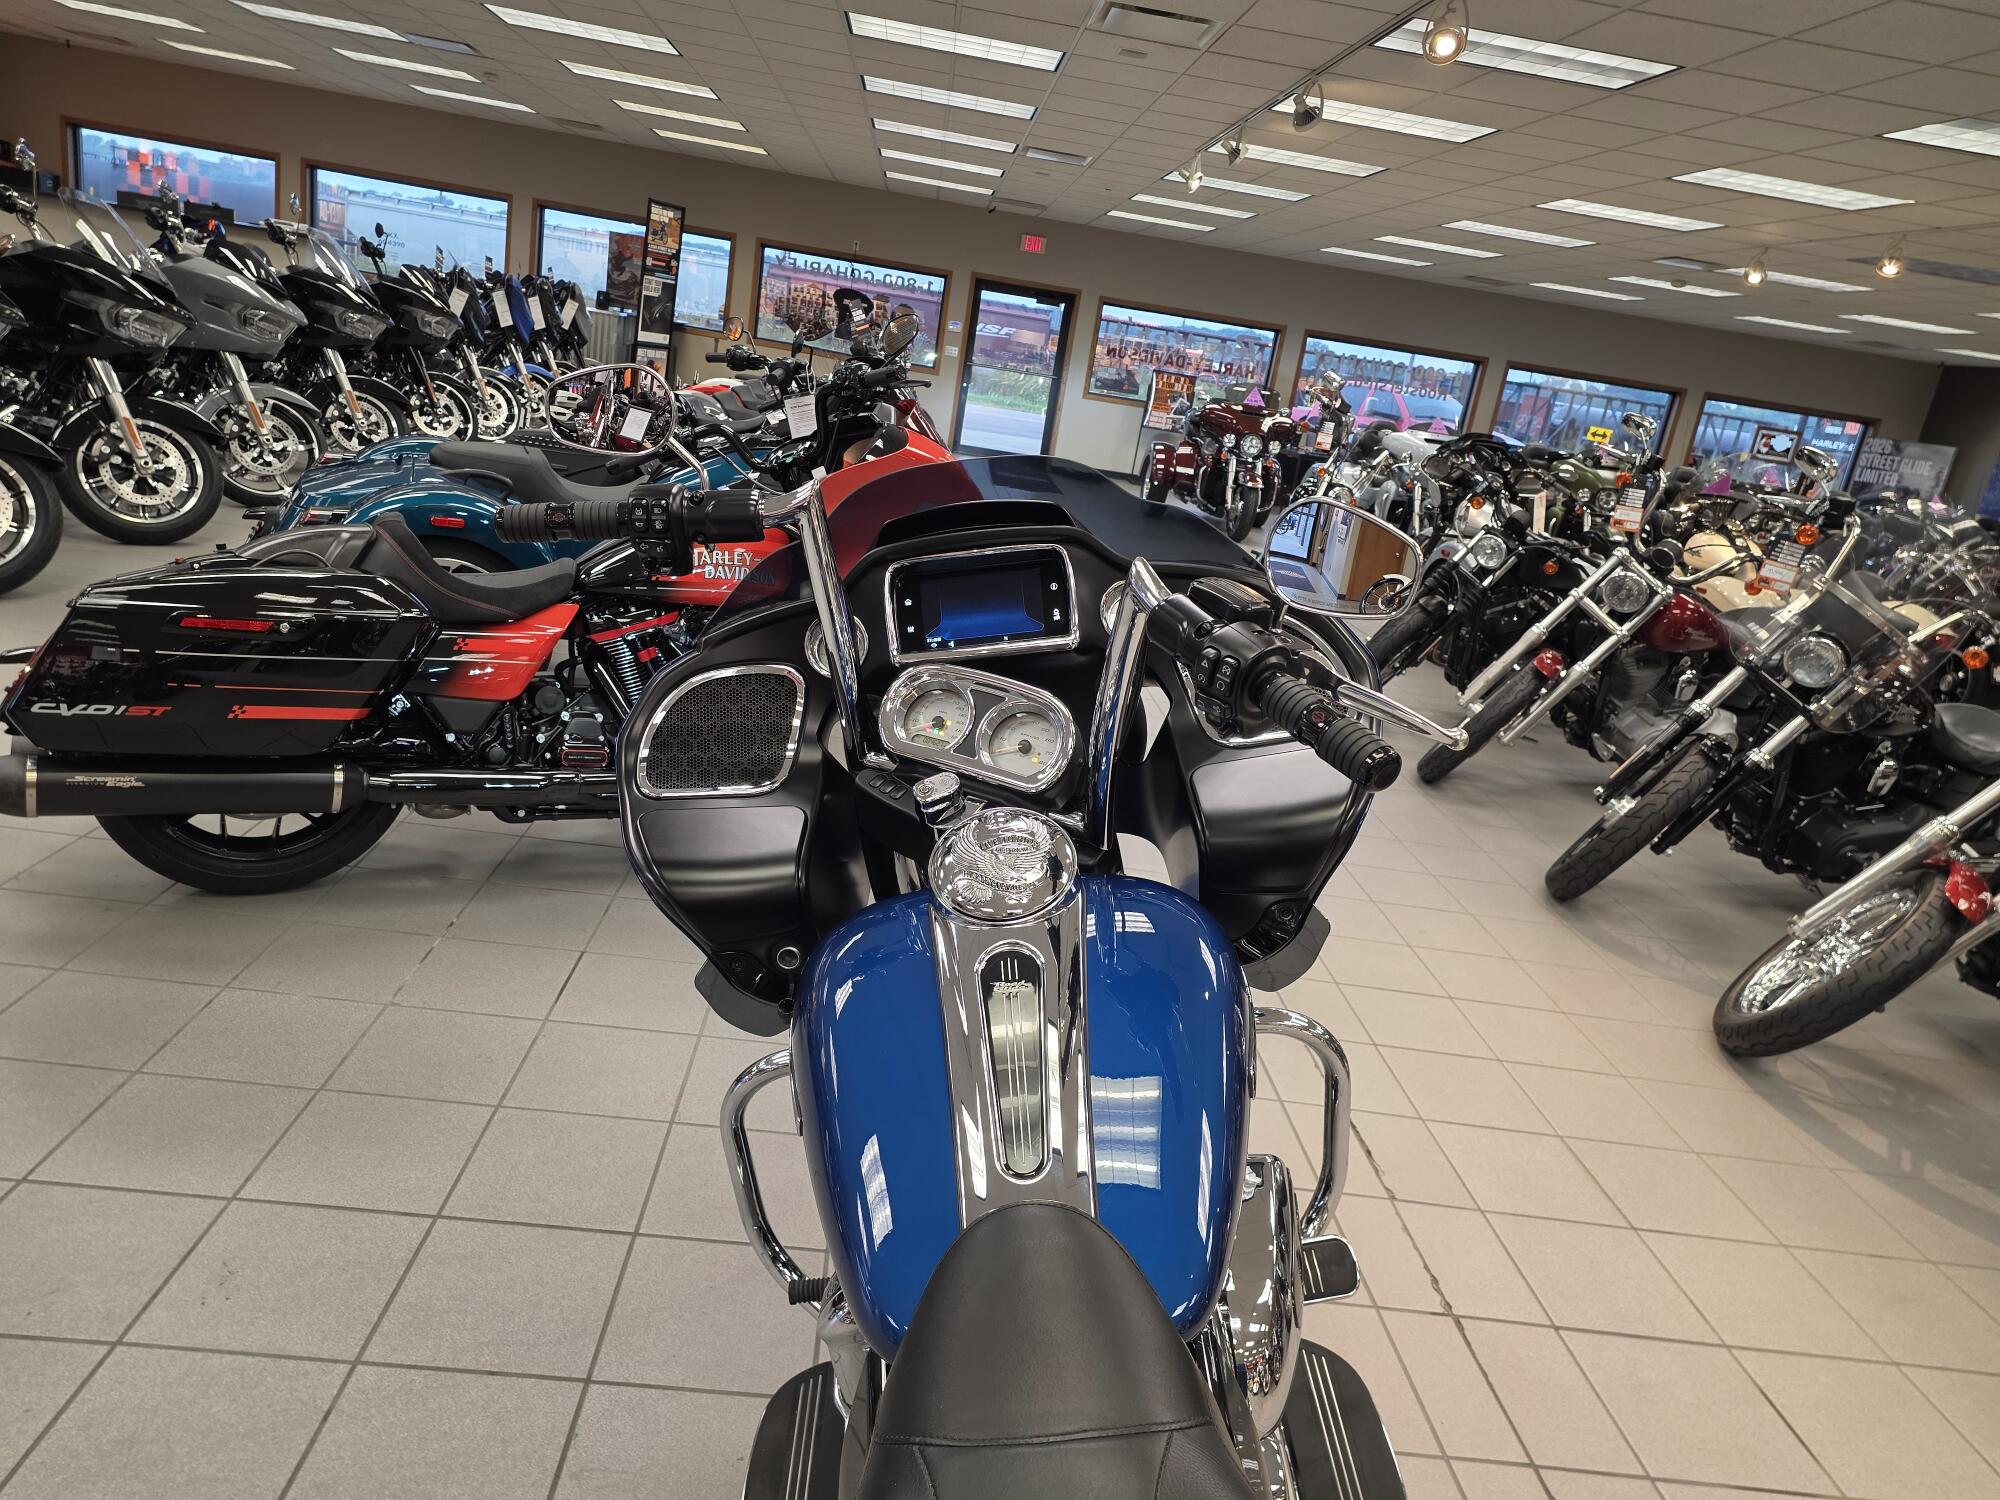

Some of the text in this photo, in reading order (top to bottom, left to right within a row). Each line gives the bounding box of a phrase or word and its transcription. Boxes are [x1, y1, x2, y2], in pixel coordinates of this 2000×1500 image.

[1024, 235, 1042, 252] EXIT
[1865, 437, 1894, 454] 2026
[1859, 453, 1933, 477] STREET GLIDE
[1854, 467, 1899, 487] LIMITED
[106, 780, 146, 788] Eagle
